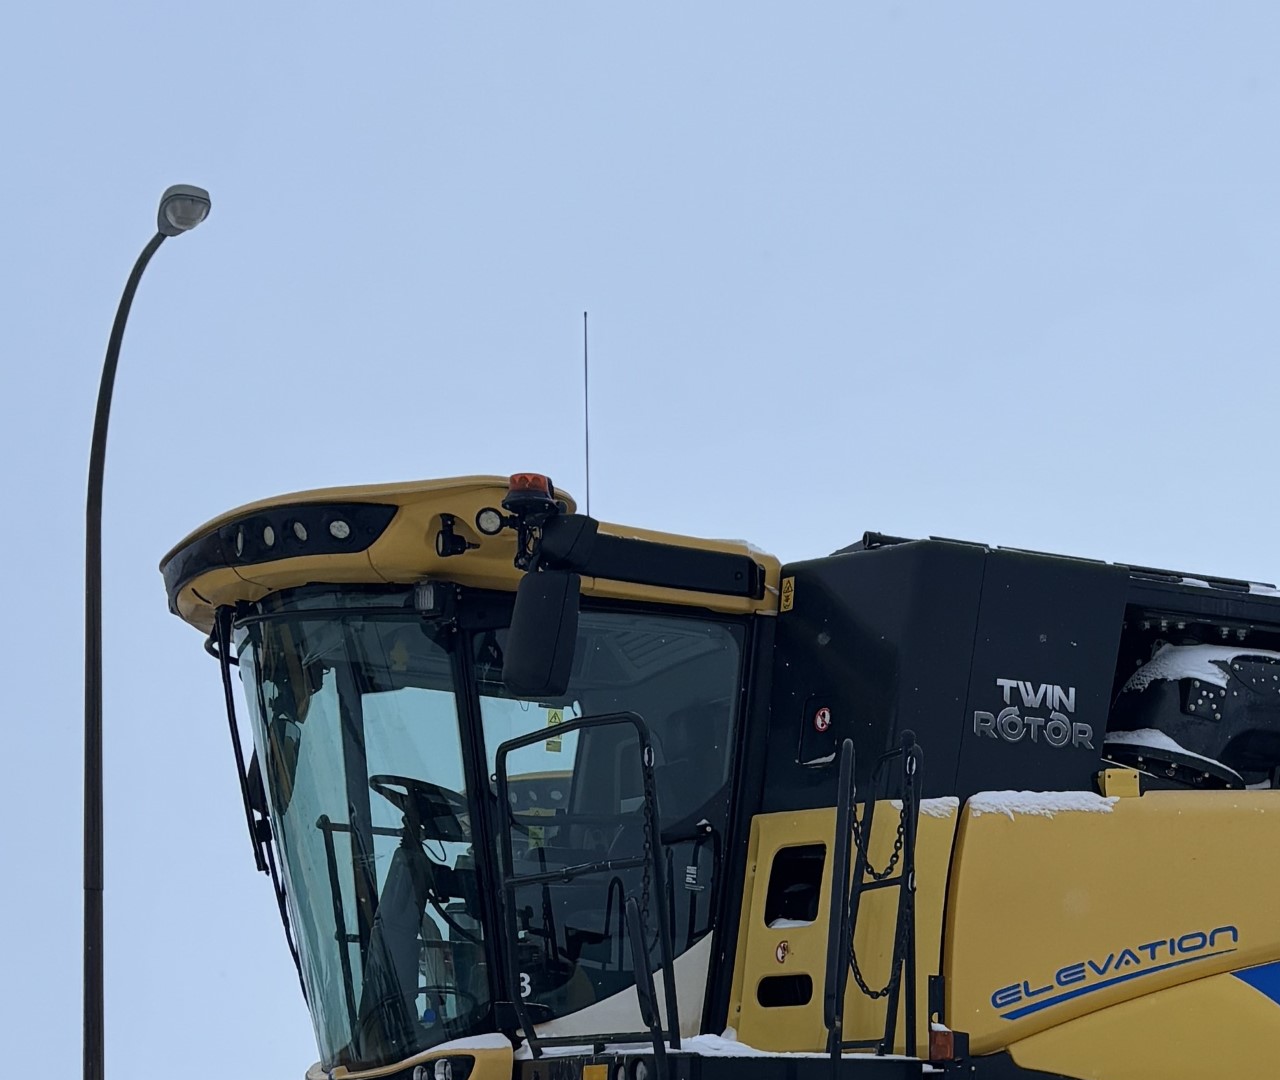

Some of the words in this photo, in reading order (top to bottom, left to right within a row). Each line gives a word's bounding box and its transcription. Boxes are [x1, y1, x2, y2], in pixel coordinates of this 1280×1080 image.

[996, 678, 1076, 713] TWIN
[973, 705, 1095, 750] ROTOR
[991, 925, 1238, 1009] ELEVATION
